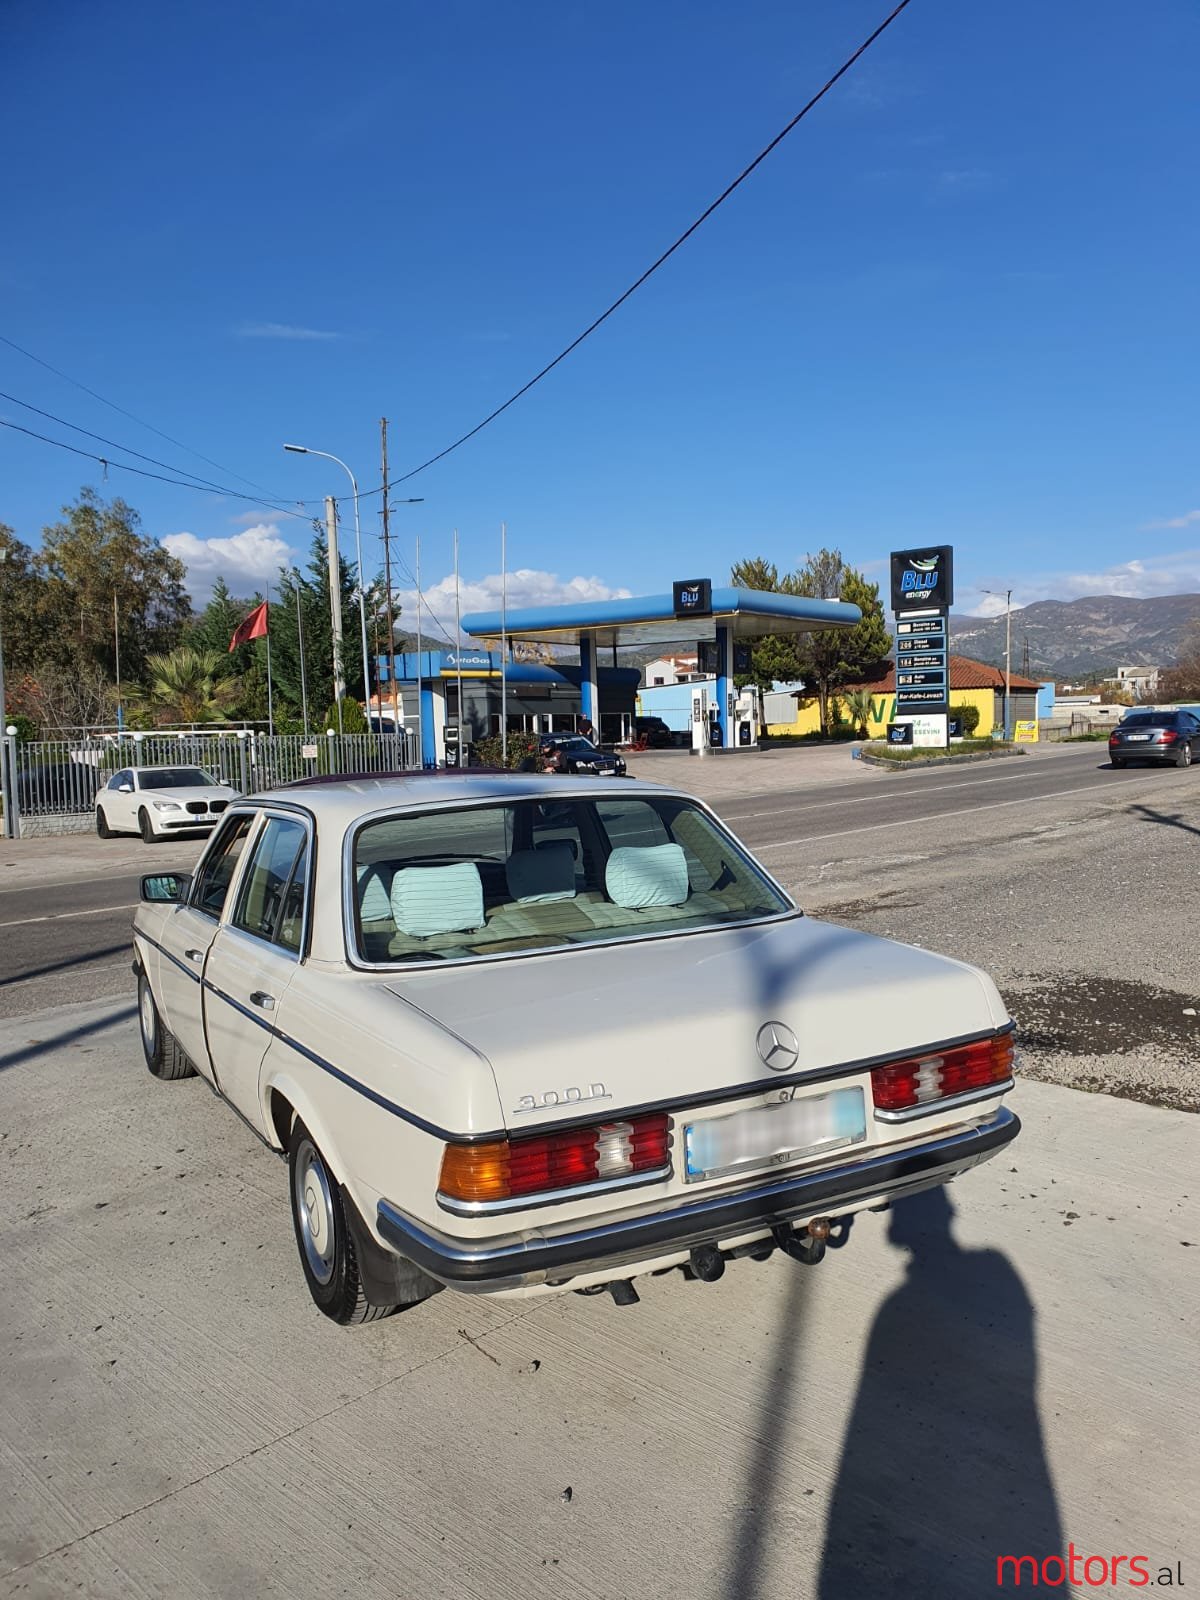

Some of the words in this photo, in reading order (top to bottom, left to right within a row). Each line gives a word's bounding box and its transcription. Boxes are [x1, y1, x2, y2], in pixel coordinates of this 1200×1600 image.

[901, 570, 938, 592] BLU
[681, 591, 699, 603] BLU
[905, 590, 932, 599] energy
